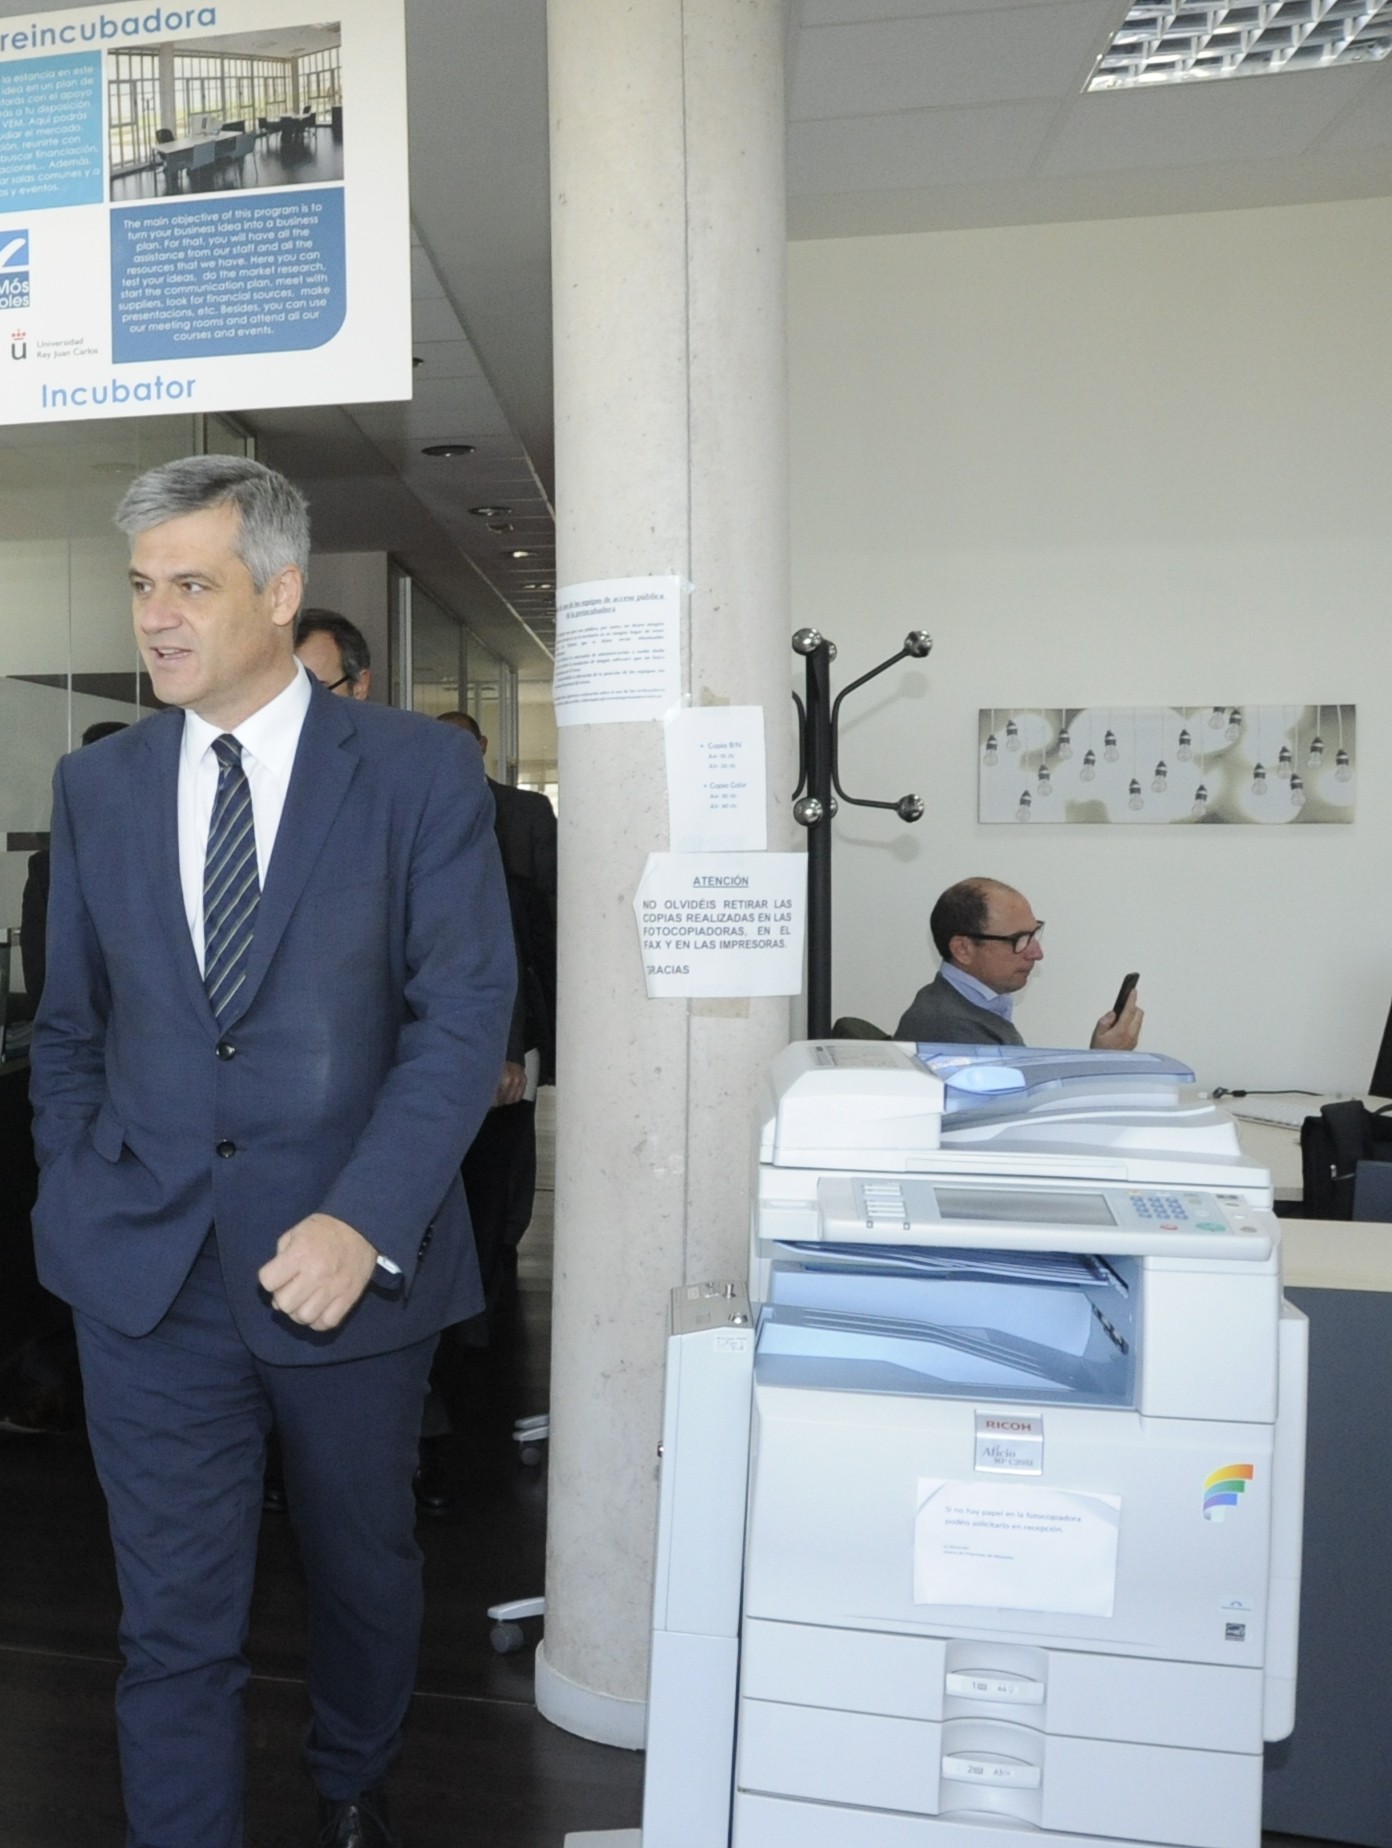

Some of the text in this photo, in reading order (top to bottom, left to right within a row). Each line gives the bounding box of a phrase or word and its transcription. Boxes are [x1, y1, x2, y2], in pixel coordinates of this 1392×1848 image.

[1, 74, 11, 84] la
[13, 71, 55, 83] estancia
[72, 65, 93, 76] este
[124, 202, 322, 228] The main objective of this program is to
[128, 229, 147, 239] turn
[150, 229, 171, 240] your
[174, 224, 215, 236] business
[217, 221, 241, 232] idea
[243, 219, 263, 230] into
[275, 216, 318, 227] business
[163, 238, 179, 248] For
[208, 236, 227, 247] you
[229, 231, 246, 242] will
[248, 230, 274, 241] have
[277, 228, 289, 238] all
[292, 227, 309, 237] the
[134, 239, 312, 262] assistance from our staff and all the
[127, 264, 174, 274] resources
[176, 259, 197, 270] that
[200, 260, 215, 268] we
[250, 254, 274, 264] Here
[277, 254, 296, 265] you
[299, 252, 320, 260] can
[123, 275, 139, 286] test
[142, 276, 163, 287] your
[202, 270, 216, 280] do
[219, 269, 236, 279] the
[238, 265, 274, 278] market
[121, 286, 142, 298] start
[144, 286, 161, 296] the
[164, 282, 244, 294] communication
[275, 274, 303, 286] meet
[305, 273, 327, 284] with
[166, 295, 187, 306] look
[190, 294, 203, 304] for
[206, 290, 250, 303] financial
[300, 286, 330, 296] make
[174, 331, 211, 341] courses
[214, 327, 235, 338] and
[37, 338, 83, 348] Universidad
[37, 348, 98, 360] Rey Juan Carlos
[43, 376, 196, 408] Incubator
[693, 874, 749, 887] ATENCIÓN
[643, 898, 792, 909] NO OLVIDÉIS RETIRAR LAS
[643, 912, 792, 923] COPIAS REALIZADAS EN LAS
[644, 926, 791, 937] FOTOCOPIADORAS, EN EL
[644, 939, 787, 949] FAX Y EN LAS IMPRESORAS.
[986, 1421, 1031, 1431] RICOH
[965, 1507, 979, 1516] hay
[981, 1509, 1003, 1517] papel
[1026, 1511, 1081, 1522] fotocopiadora
[945, 1519, 970, 1527] podéis
[968, 1765, 973, 1773] 2
